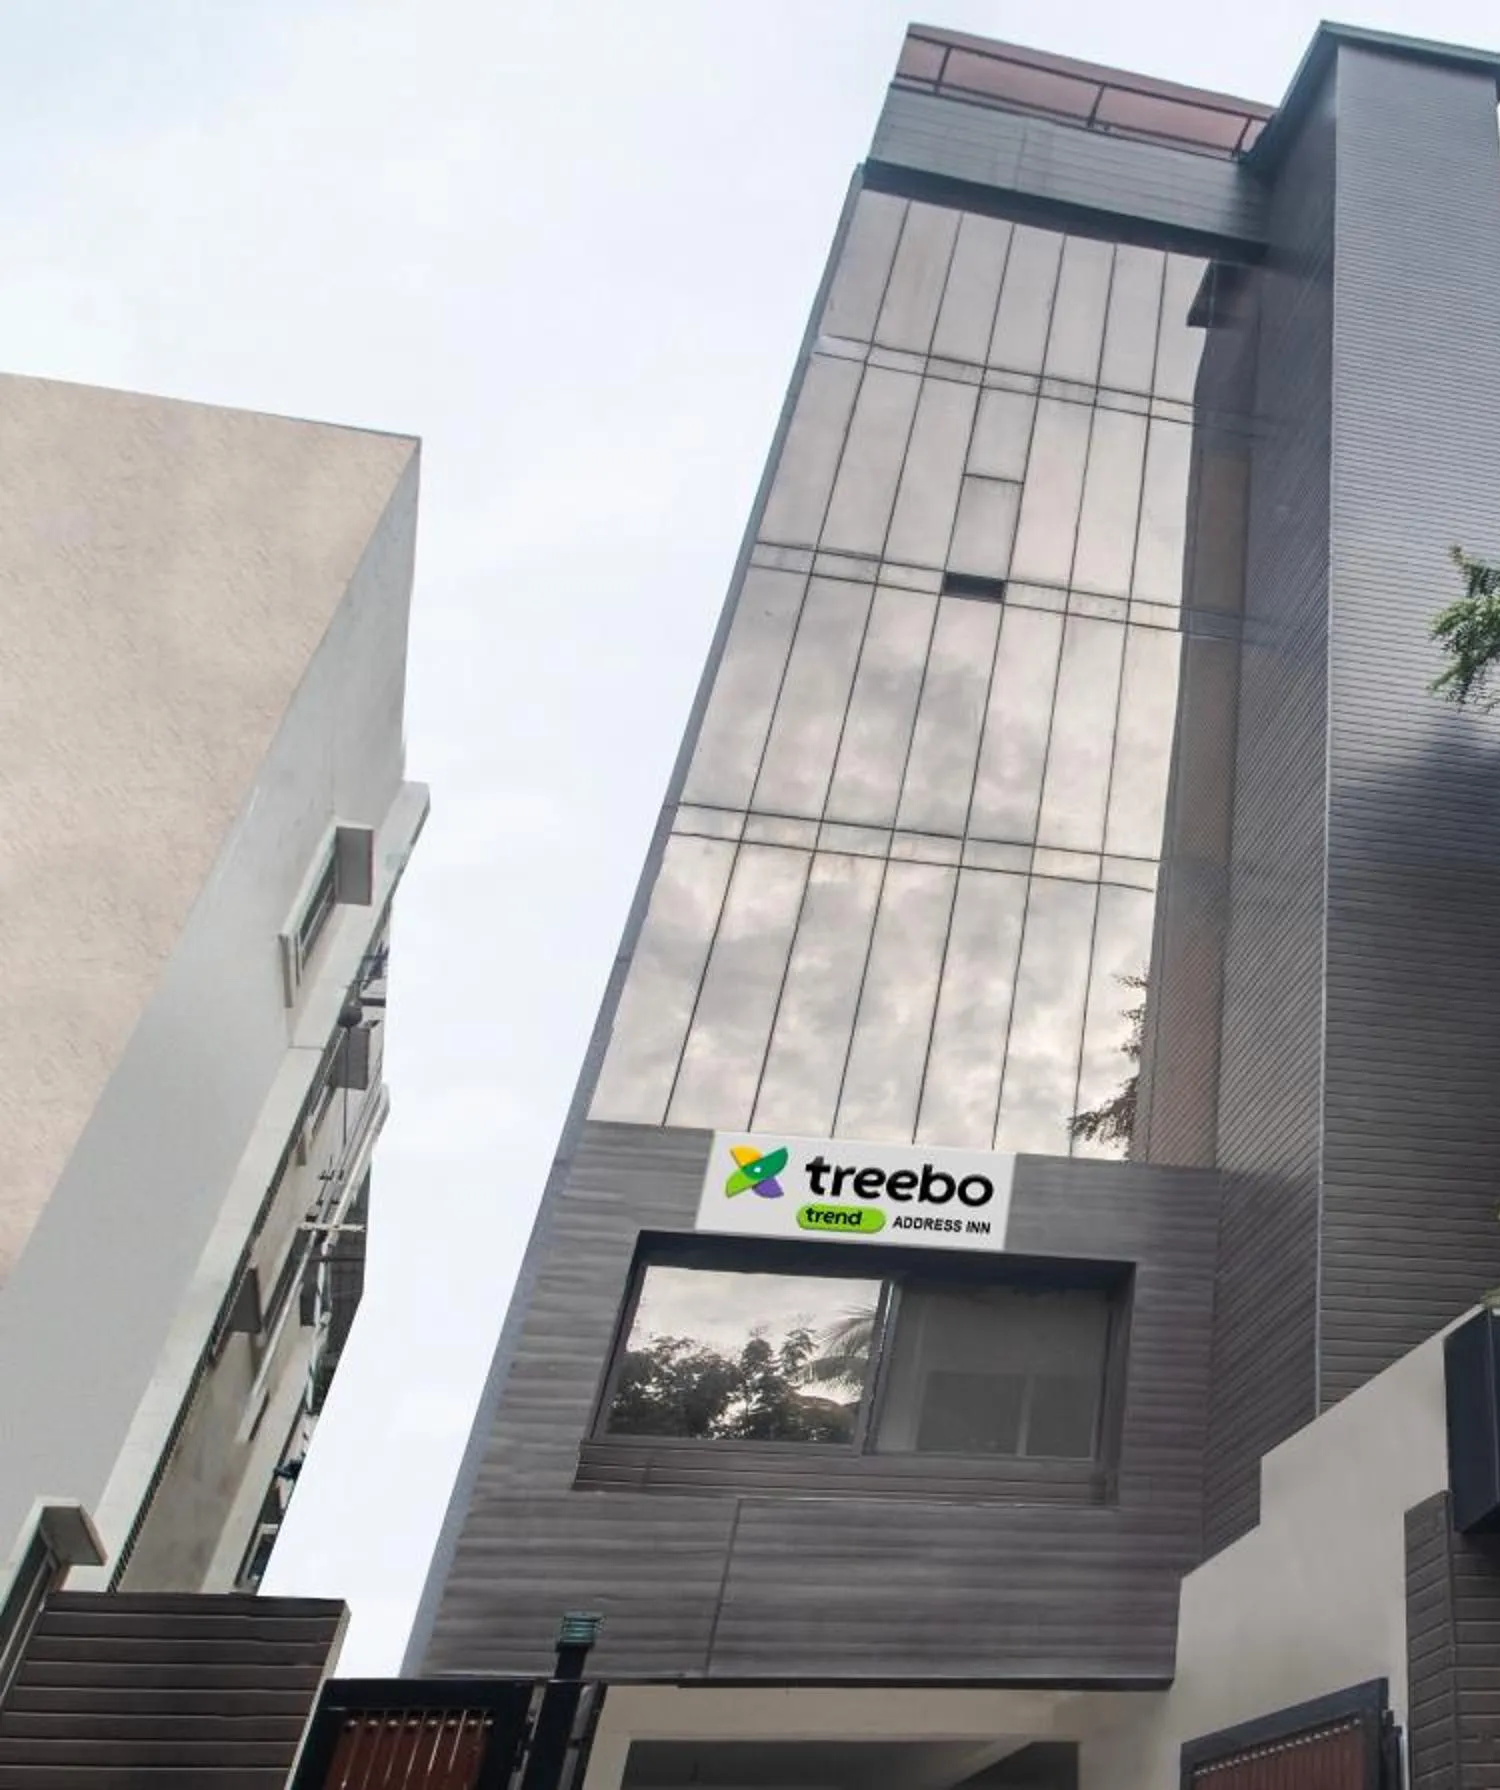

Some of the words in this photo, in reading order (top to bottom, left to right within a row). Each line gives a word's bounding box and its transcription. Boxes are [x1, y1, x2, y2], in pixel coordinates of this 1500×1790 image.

[805, 1156, 994, 1206] treebo
[805, 1207, 863, 1225] trend
[892, 1216, 962, 1233] ADDRESS
[966, 1221, 991, 1234] INN
